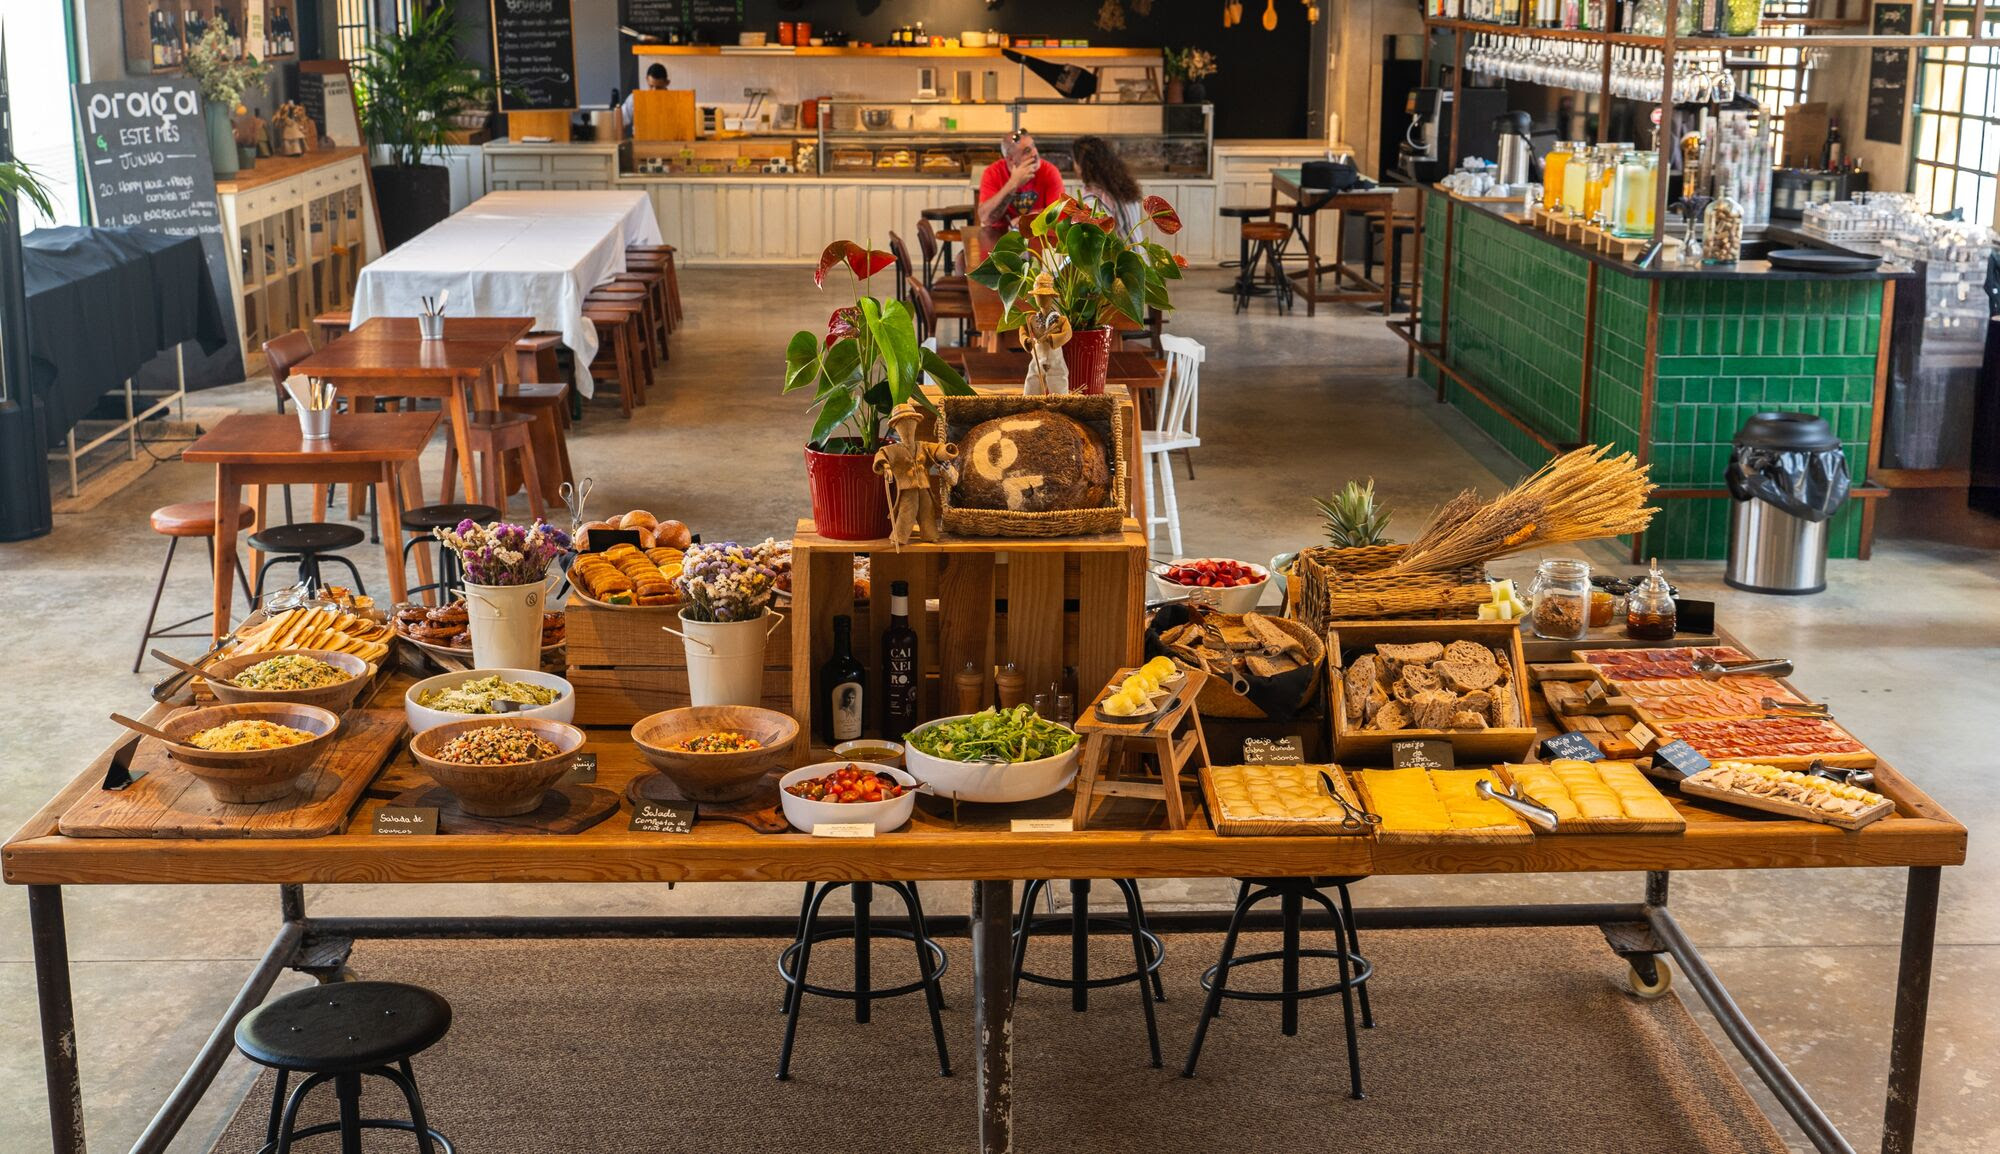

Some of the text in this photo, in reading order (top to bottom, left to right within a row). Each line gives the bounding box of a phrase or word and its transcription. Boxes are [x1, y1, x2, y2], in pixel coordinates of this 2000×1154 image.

[87, 86, 199, 134] praça
[119, 126, 153, 146] ESTE
[890, 648, 911, 658] CAI
[891, 661, 911, 671] XEI
[641, 806, 677, 817] Salada
[380, 813, 424, 823] Salada de
